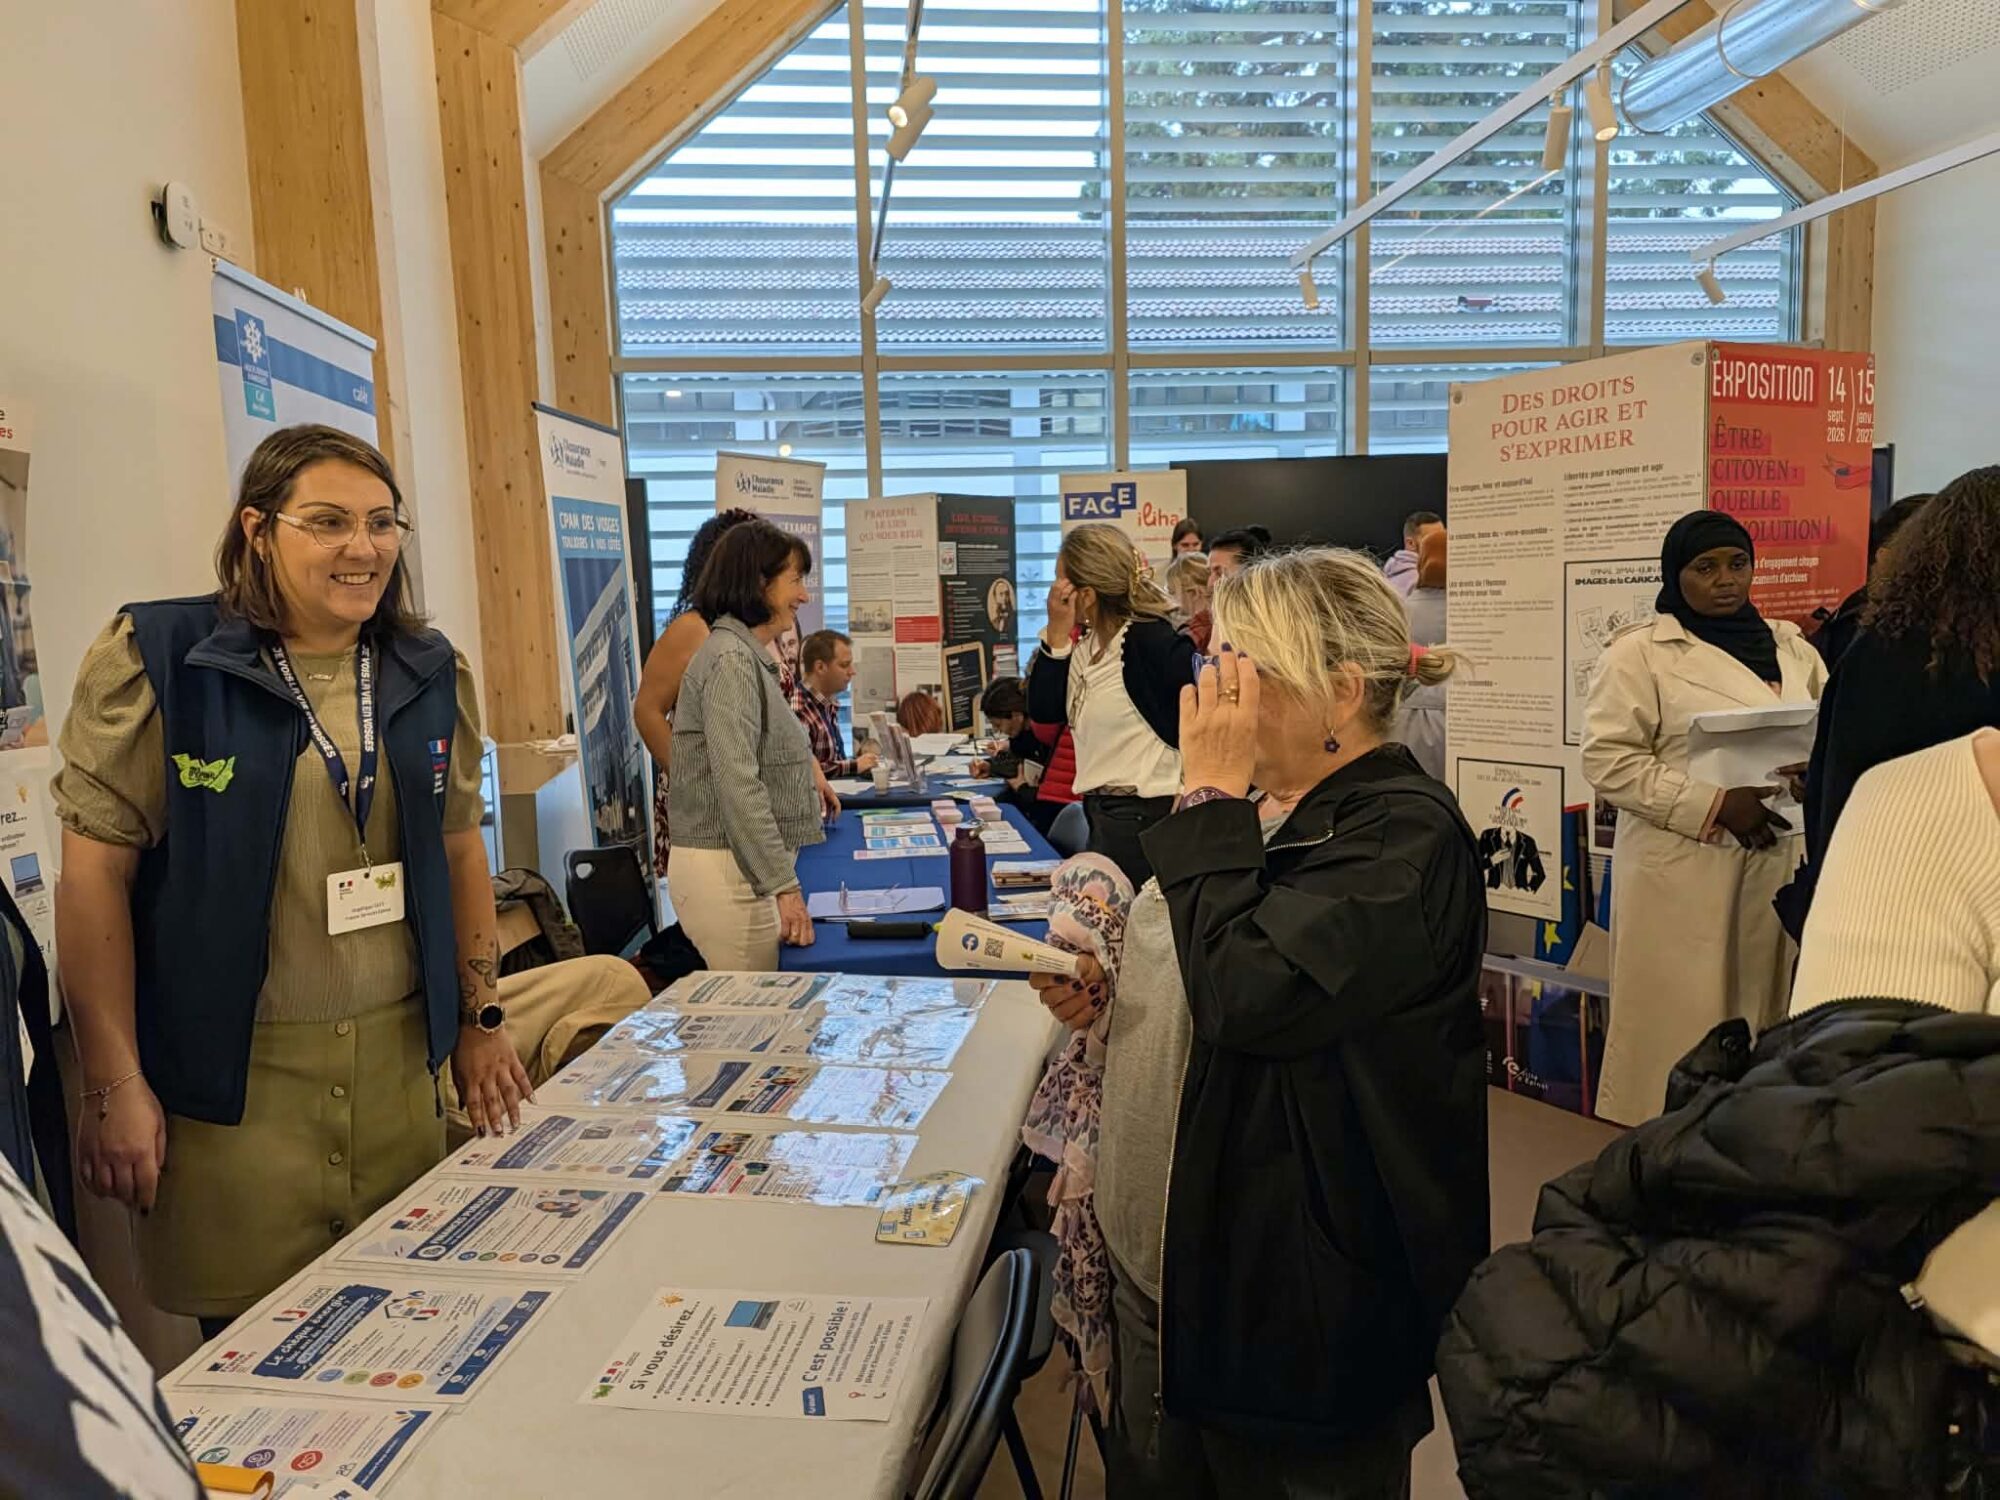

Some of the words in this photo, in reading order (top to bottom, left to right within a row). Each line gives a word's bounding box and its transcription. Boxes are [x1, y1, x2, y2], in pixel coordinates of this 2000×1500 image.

[1502, 393, 1544, 415] DES
[1552, 375, 1635, 407] DROITS
[1711, 359, 1814, 402] EXPOSITION
[1828, 366, 1846, 403] 14
[1858, 368, 1874, 405] 15
[1491, 417, 1548, 440] POUR
[1556, 406, 1609, 431] AGIR
[1617, 400, 1648, 422] ET
[1828, 409, 1846, 424] sept.
[1714, 414, 1763, 449] ÊTRE
[1827, 427, 1846, 443] 2026
[1500, 429, 1635, 463] S'EXPRIMER
[1711, 458, 1790, 482] CITOYEN
[1068, 487, 1132, 516] FACE
[1712, 489, 1782, 512] QUELLE
[559, 512, 581, 529] CPAM
[582, 514, 595, 531] DES
[597, 516, 620, 533] VOSGES
[1575, 577, 1608, 586] IMAGES
[272, 647, 285, 658] JE
[278, 659, 294, 682] VOIS
[361, 657, 370, 678] VOIS
[296, 693, 309, 710] VIE
[310, 722, 337, 759] VOSGES
[363, 718, 374, 753] VOSGES
[629, 1380, 648, 1390] Si
[640, 1350, 668, 1377] vous
[659, 1301, 700, 1348] désirez...
[802, 1353, 828, 1382] C'est
[819, 1306, 849, 1351] possible
